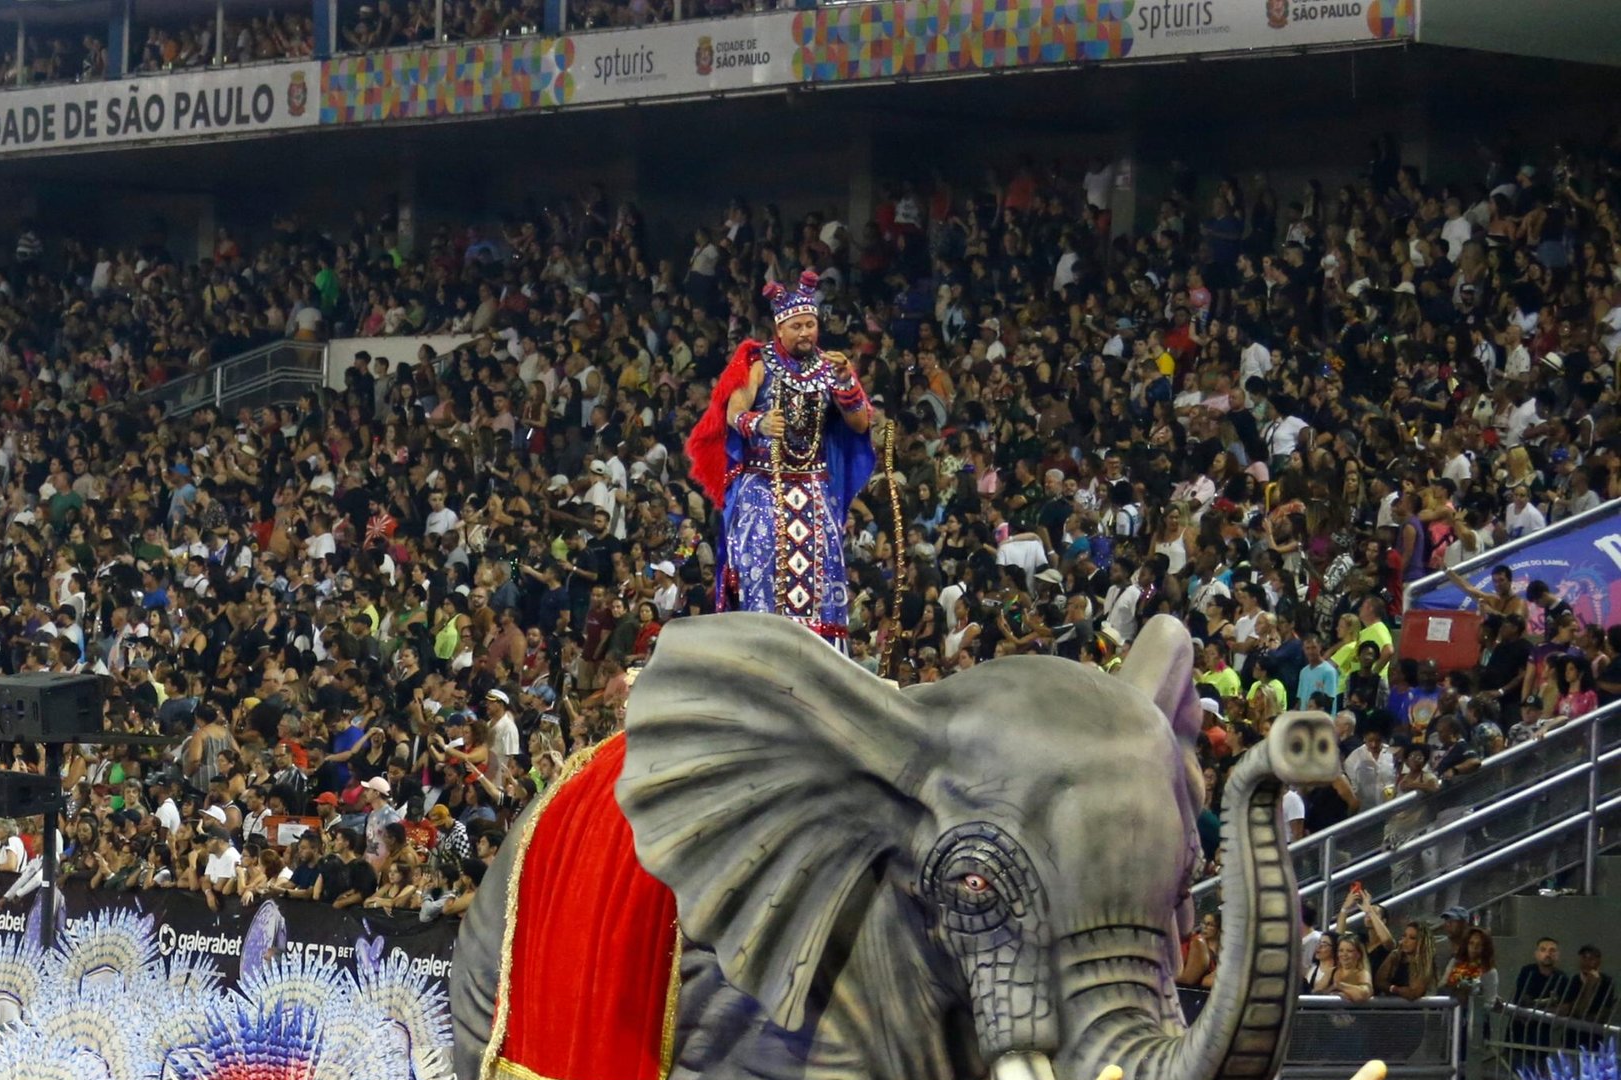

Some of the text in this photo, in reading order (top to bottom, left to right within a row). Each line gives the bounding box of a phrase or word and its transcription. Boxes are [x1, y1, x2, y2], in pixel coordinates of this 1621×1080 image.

[1137, 0, 1212, 38] spturis
[1292, 2, 1362, 21] SÃO PAULO
[715, 38, 758, 52] CIDADE DE
[594, 45, 654, 85] spturis
[715, 51, 770, 69] SÃO PAULO
[64, 102, 97, 140] DE
[106, 84, 165, 136] SÃO
[175, 83, 275, 127] PAULO
[178, 931, 242, 957] galerabet
